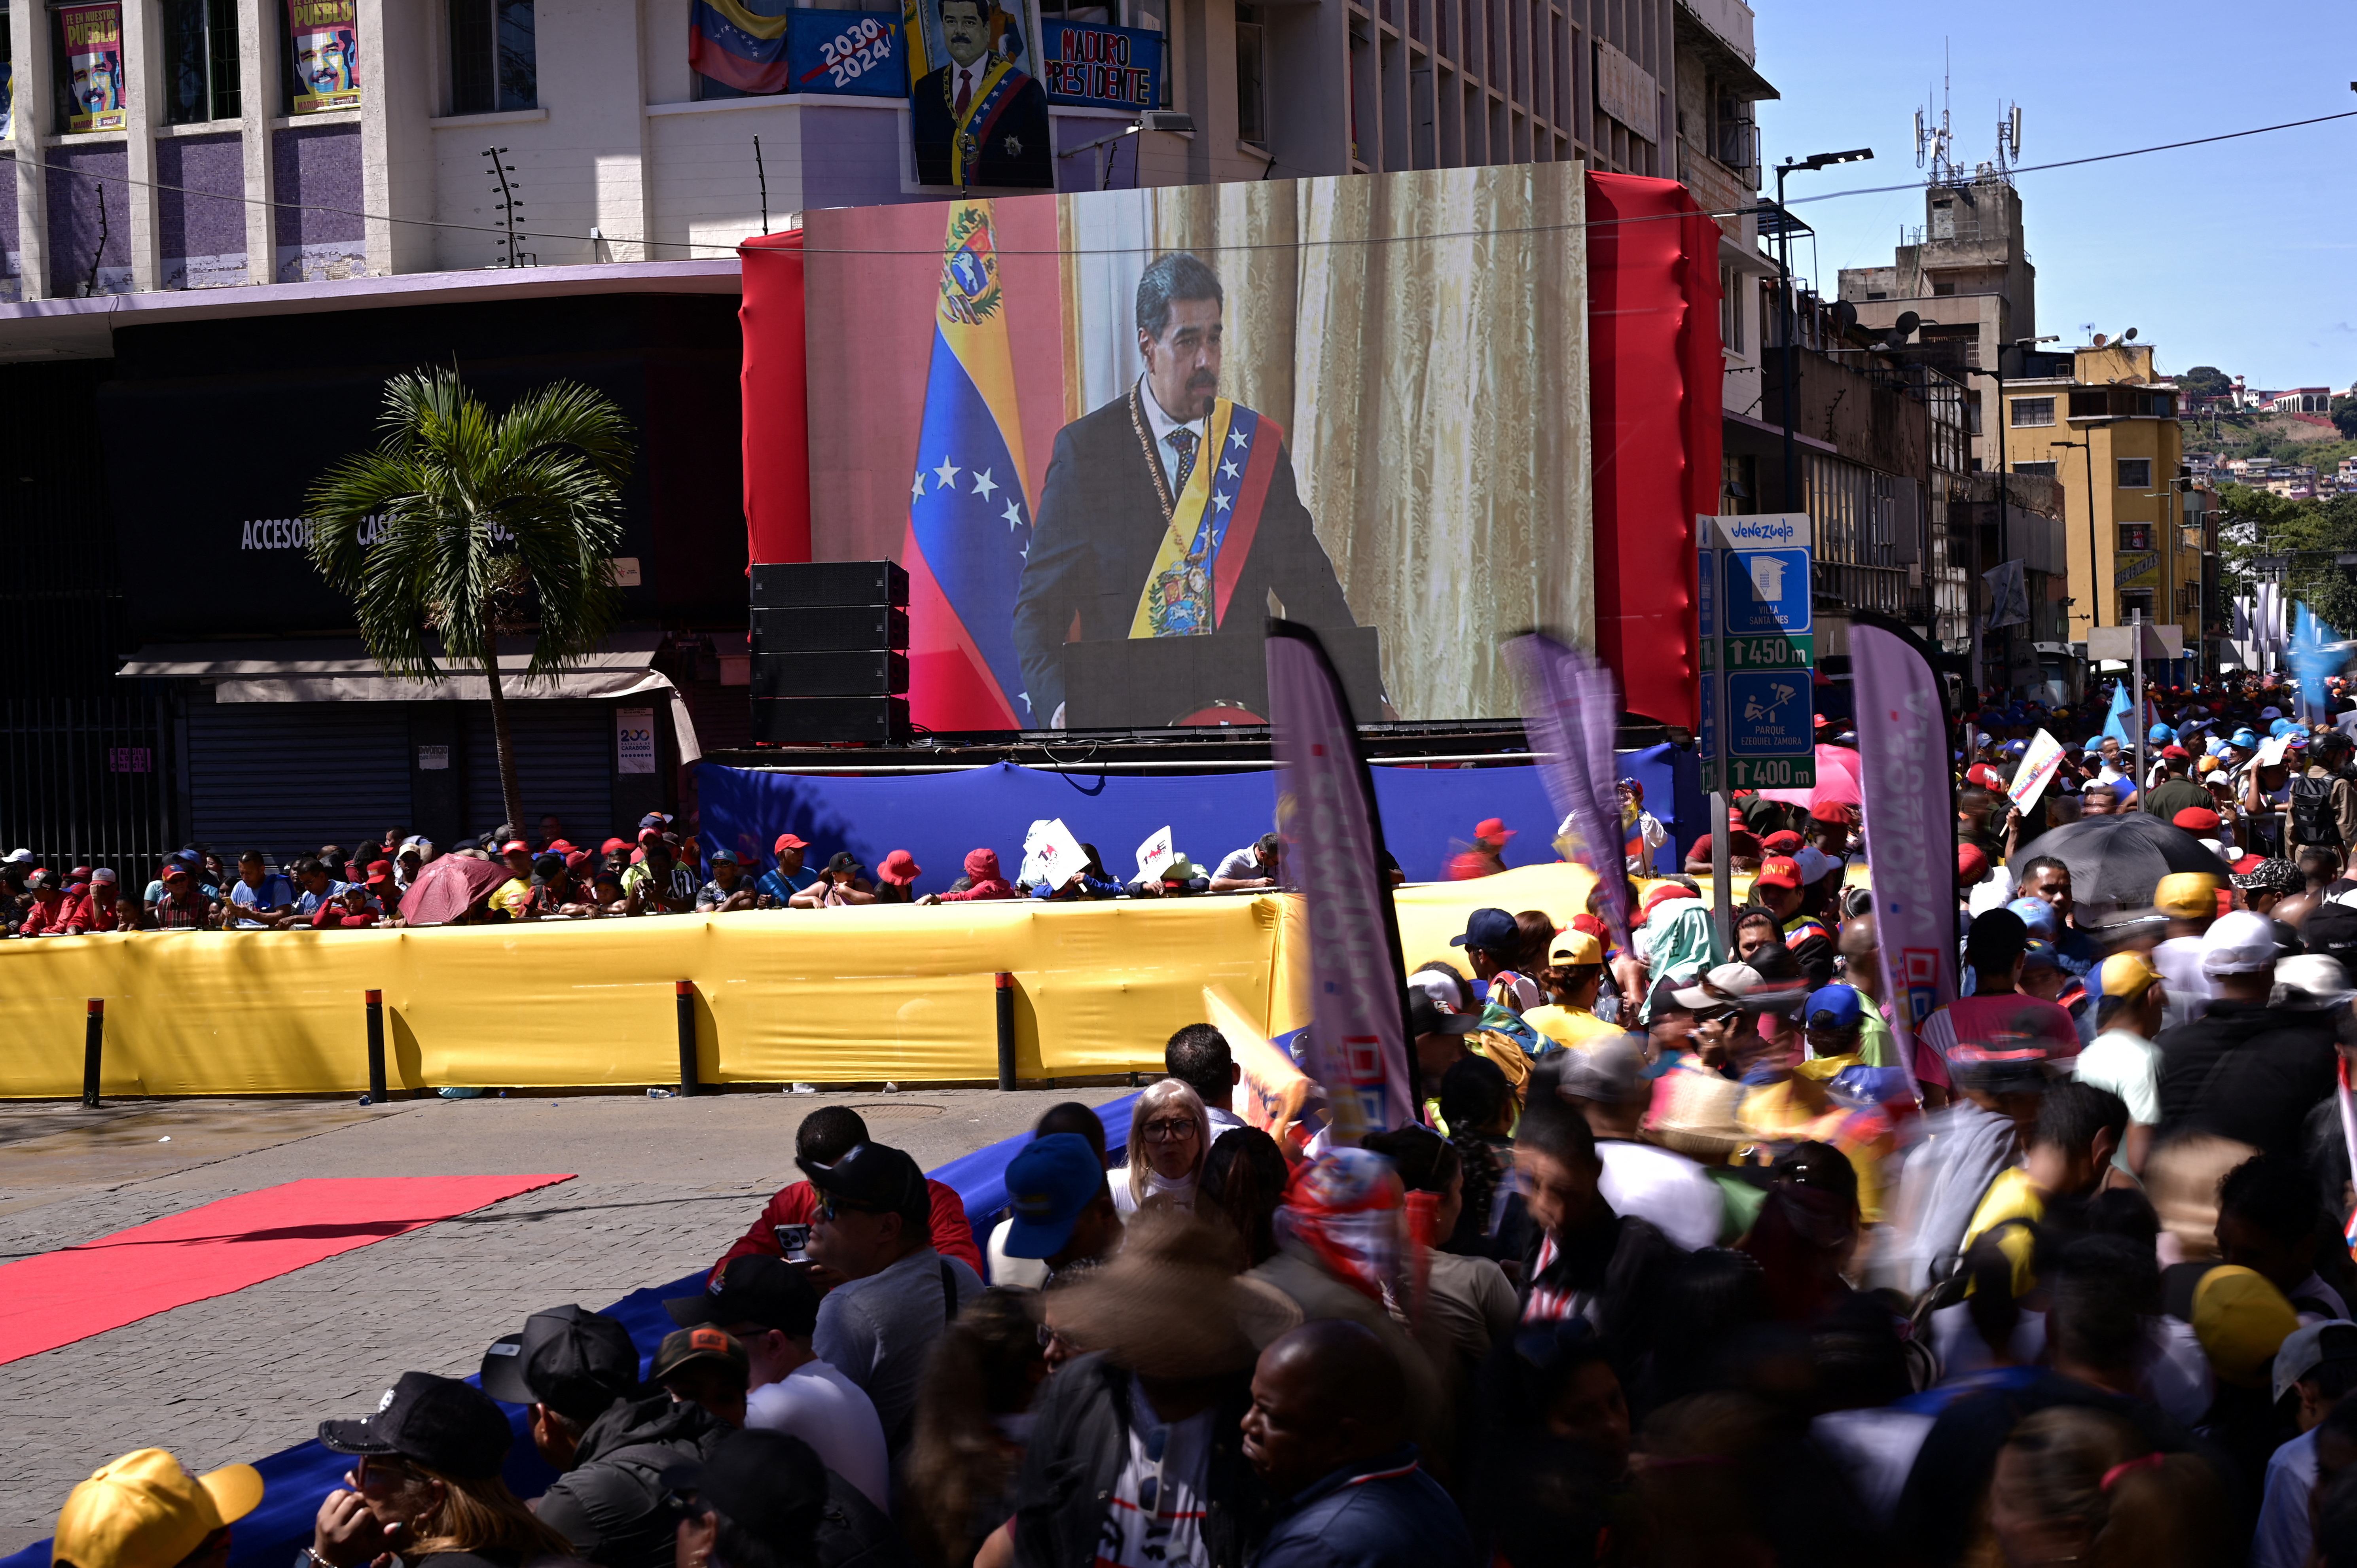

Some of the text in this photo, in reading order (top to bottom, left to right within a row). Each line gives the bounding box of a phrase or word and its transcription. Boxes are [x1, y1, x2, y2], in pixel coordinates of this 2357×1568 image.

[66, 9, 116, 25] FE EN NUESTRO
[294, 0, 352, 28] PUEBLO
[67, 20, 117, 47] PUEBLO
[819, 18, 878, 66] 2030
[1062, 28, 1130, 67] MADURO
[829, 38, 890, 88] 2024
[1044, 59, 1150, 105] PRESIDENTE
[2115, 553, 2158, 587] HERENCIAS
[1749, 615, 1789, 625] SANTA INES
[1759, 605, 1779, 614] VILLA
[1749, 638, 1806, 664] 450 m
[621, 729, 650, 742] 200
[1741, 737, 1802, 745] EZEQUIEL ZAMORA
[1755, 726, 1785, 735] PARQUE
[1753, 760, 1809, 784] 400 m
[1883, 732, 1911, 894] SOMOS
[1763, 864, 1790, 876] SENIAT
[1963, 867, 1982, 882] ARMY
